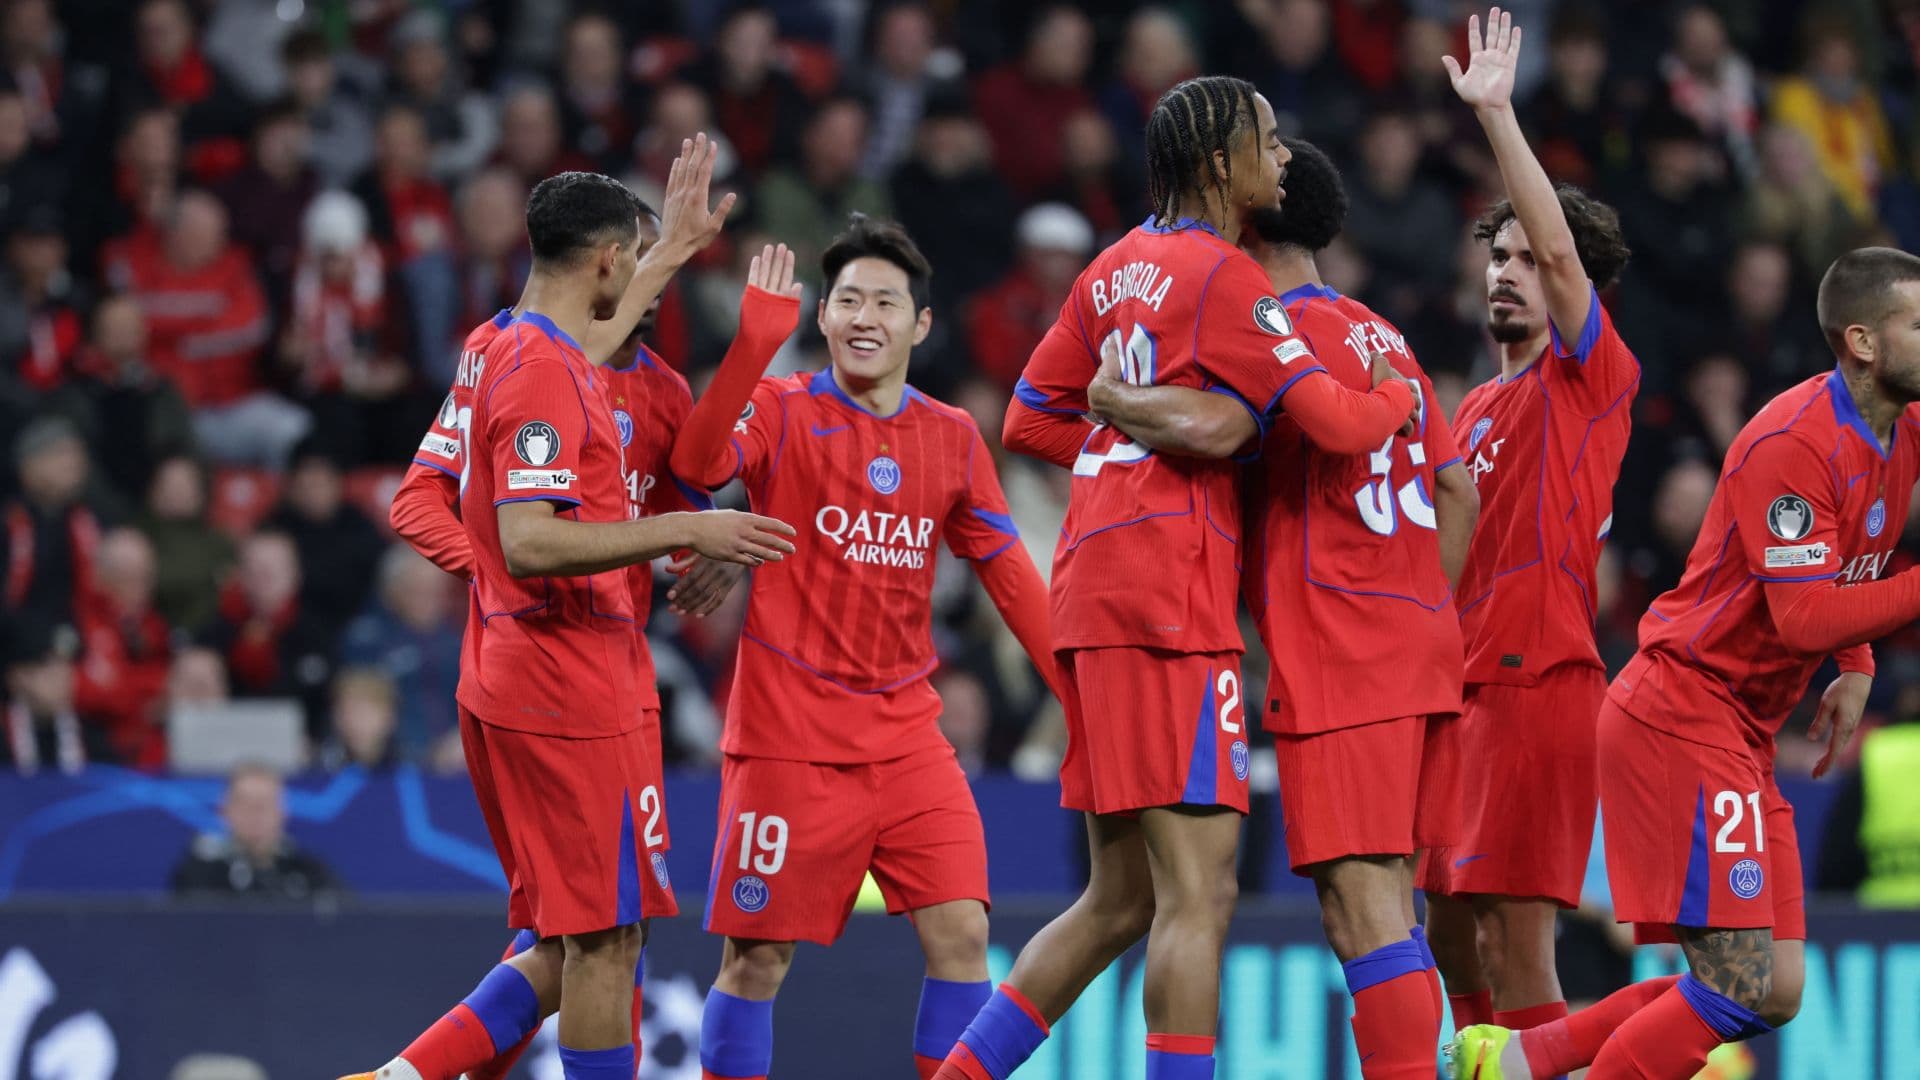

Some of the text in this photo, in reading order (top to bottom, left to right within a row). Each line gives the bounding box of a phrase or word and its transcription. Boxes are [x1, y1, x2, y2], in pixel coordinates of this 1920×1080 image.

[1092, 261, 1173, 317] B.BARCOLA
[551, 474, 568, 485] 10
[816, 505, 934, 548] QATAR
[844, 542, 925, 569] AIRWAYS
[1807, 549, 1823, 560] 10
[1216, 669, 1246, 735] 2
[640, 784, 664, 849] 2
[1713, 790, 1764, 853] 21
[738, 811, 789, 875] 19
[739, 876, 763, 888] PARIS
[1735, 860, 1757, 871] PARIS
